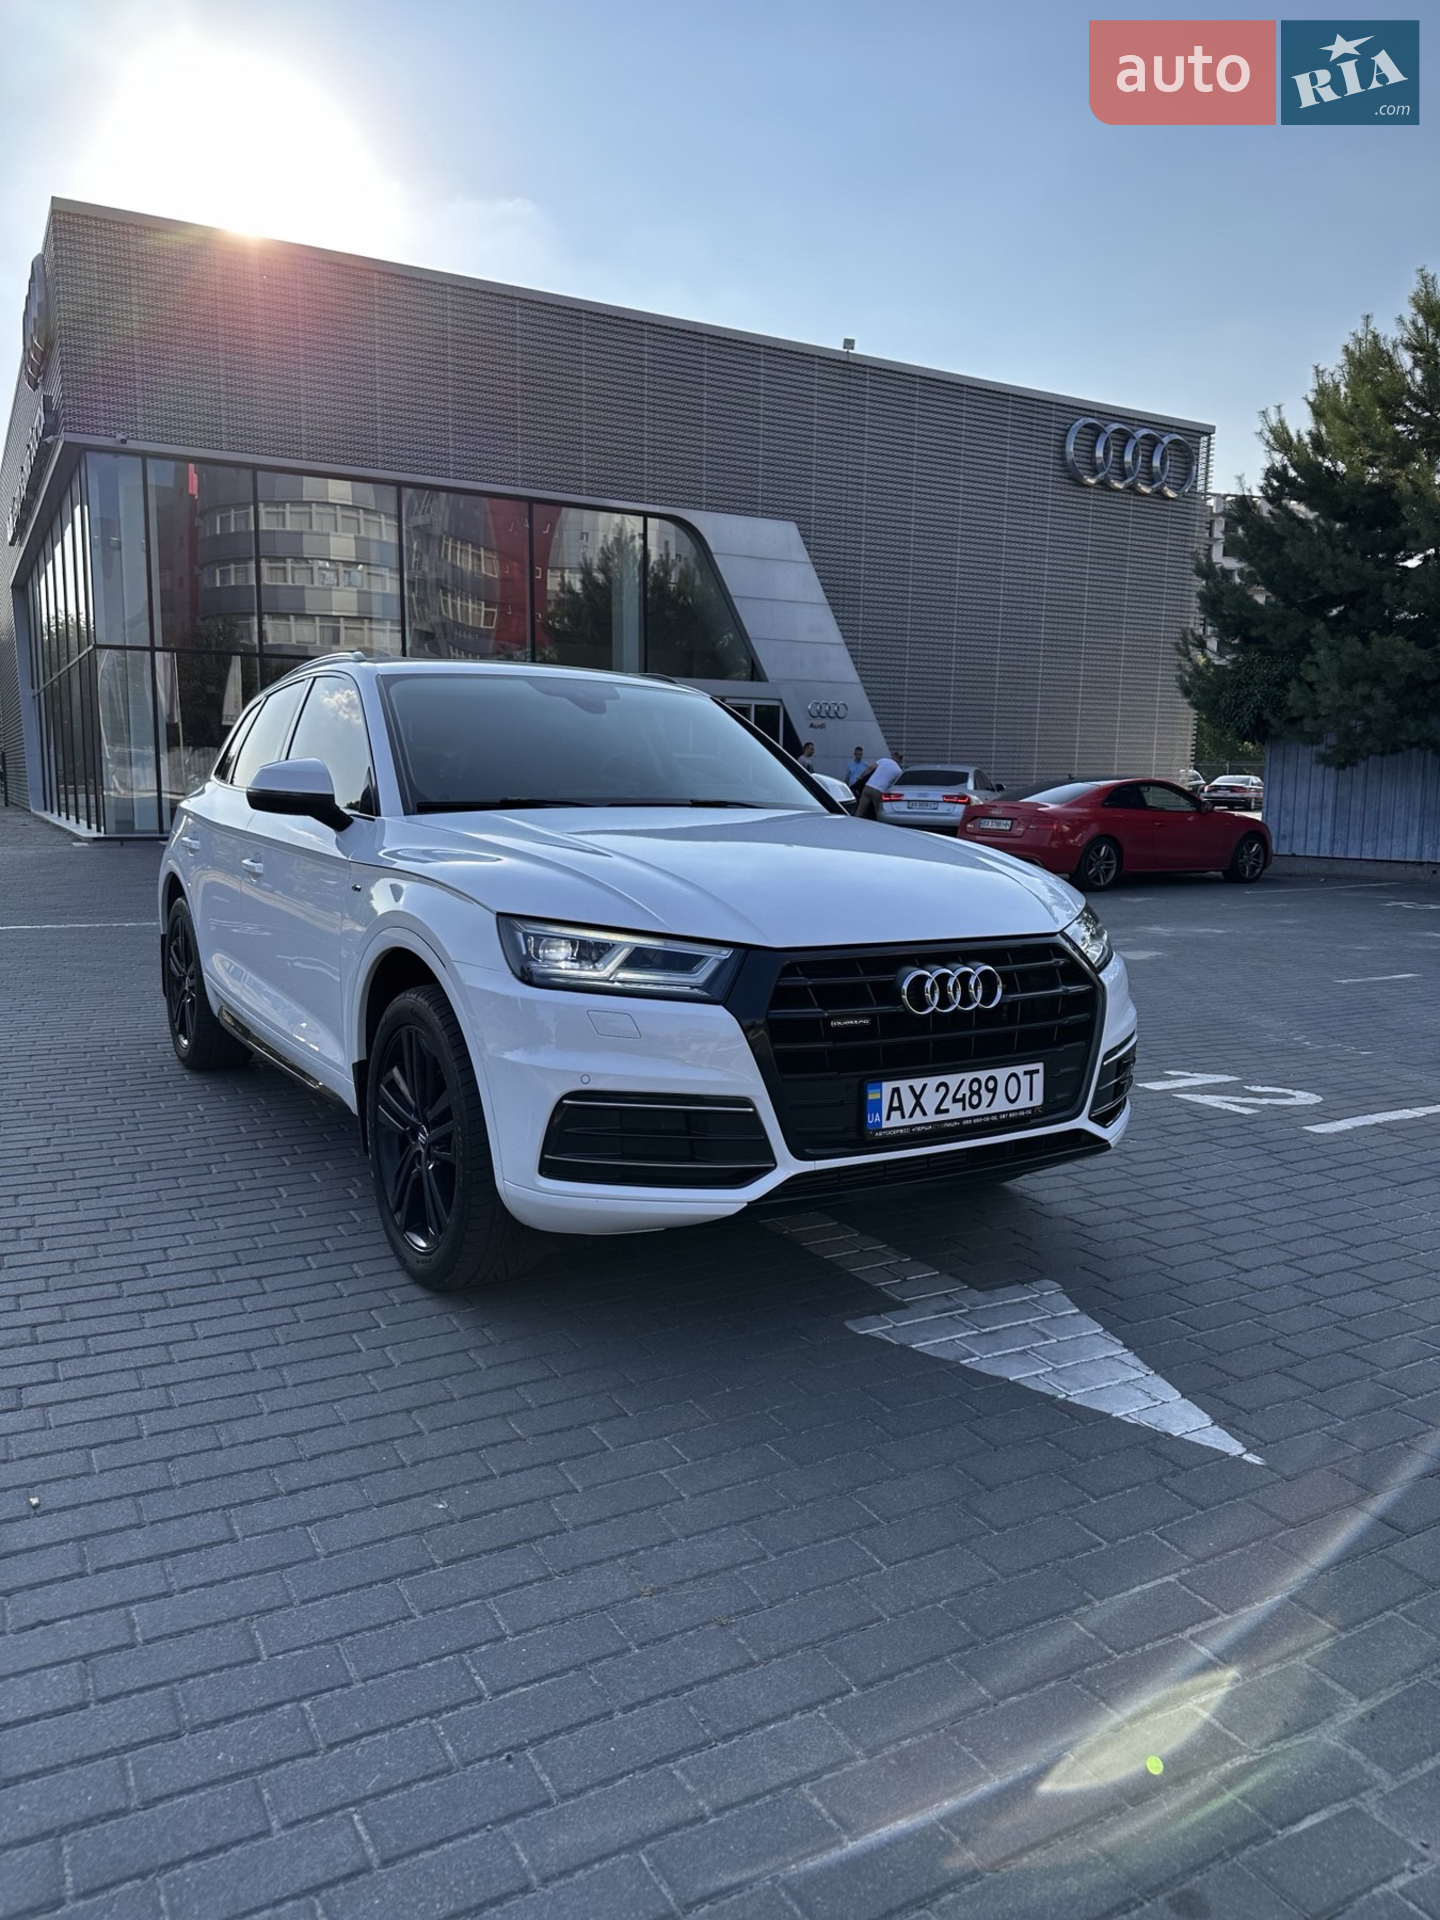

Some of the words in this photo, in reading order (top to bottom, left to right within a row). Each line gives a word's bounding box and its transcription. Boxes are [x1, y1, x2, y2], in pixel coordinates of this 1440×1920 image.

[809, 722, 826, 730] Audi
[885, 1082, 929, 1122] AX
[933, 1074, 999, 1116] 2489
[1004, 1068, 1041, 1105] OT
[867, 1111, 881, 1124] UA
